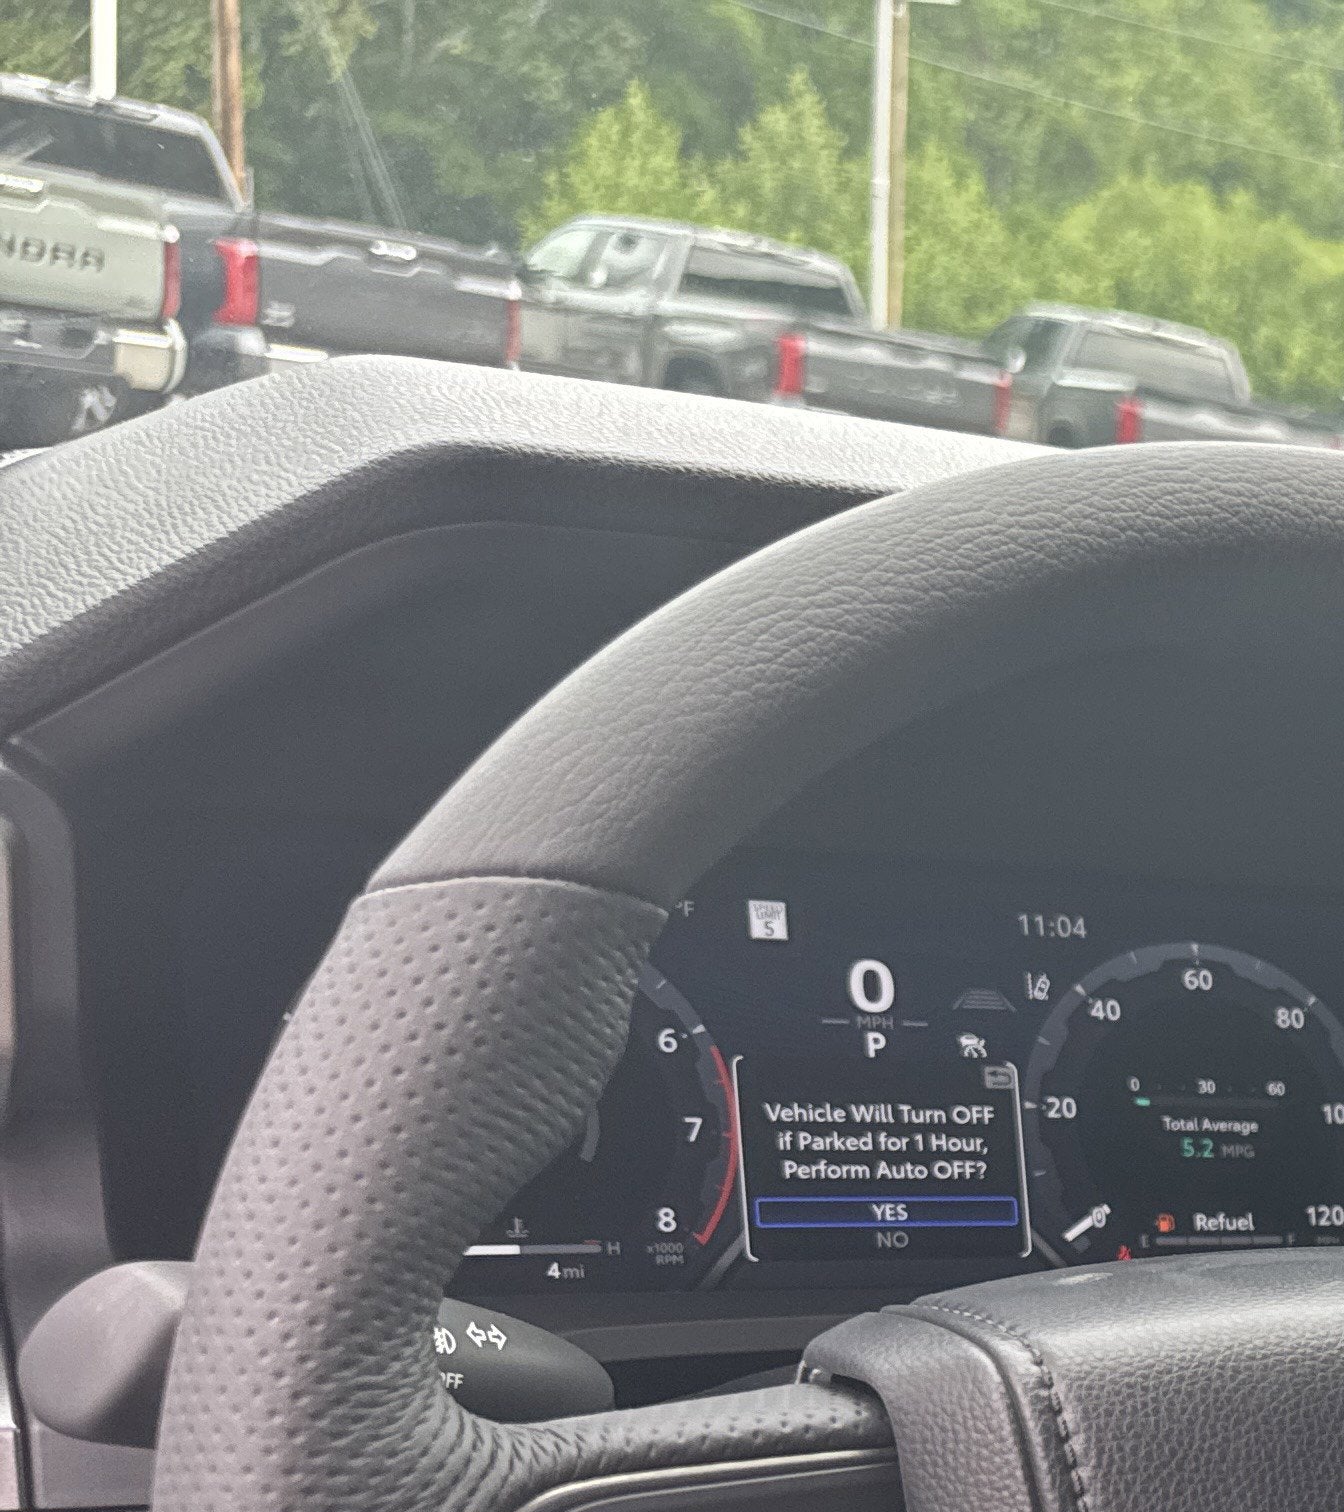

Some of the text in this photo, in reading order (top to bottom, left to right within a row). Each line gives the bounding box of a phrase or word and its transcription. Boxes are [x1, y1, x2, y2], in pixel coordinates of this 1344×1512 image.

[1018, 914, 1086, 938] 11:04
[849, 958, 895, 1013] 0
[1183, 968, 1213, 991] 60
[857, 1015, 894, 1029] MPH
[1090, 999, 1121, 1022] 40
[1274, 1006, 1305, 1029] 80
[657, 1028, 678, 1053] 6
[865, 1031, 887, 1058] P
[1129, 1077, 1140, 1092] 0
[763, 1102, 995, 1125] Vehicle Will Turn OFF
[1046, 1096, 1077, 1119] 20
[684, 1116, 703, 1142] 7
[1162, 1115, 1259, 1136] Total Average
[776, 1131, 988, 1155] if Parked for 1 Hour,
[1181, 1137, 1255, 1159] 5.2 MPG
[782, 1159, 988, 1180] Perform Auto OFF?
[657, 1206, 678, 1232] 8
[871, 1203, 909, 1221] YES
[1193, 1212, 1255, 1232] Refuel
[1307, 1205, 1344, 1227] 120
[607, 1241, 621, 1255] H
[876, 1231, 909, 1248] NO
[656, 1253, 685, 1265] RPM
